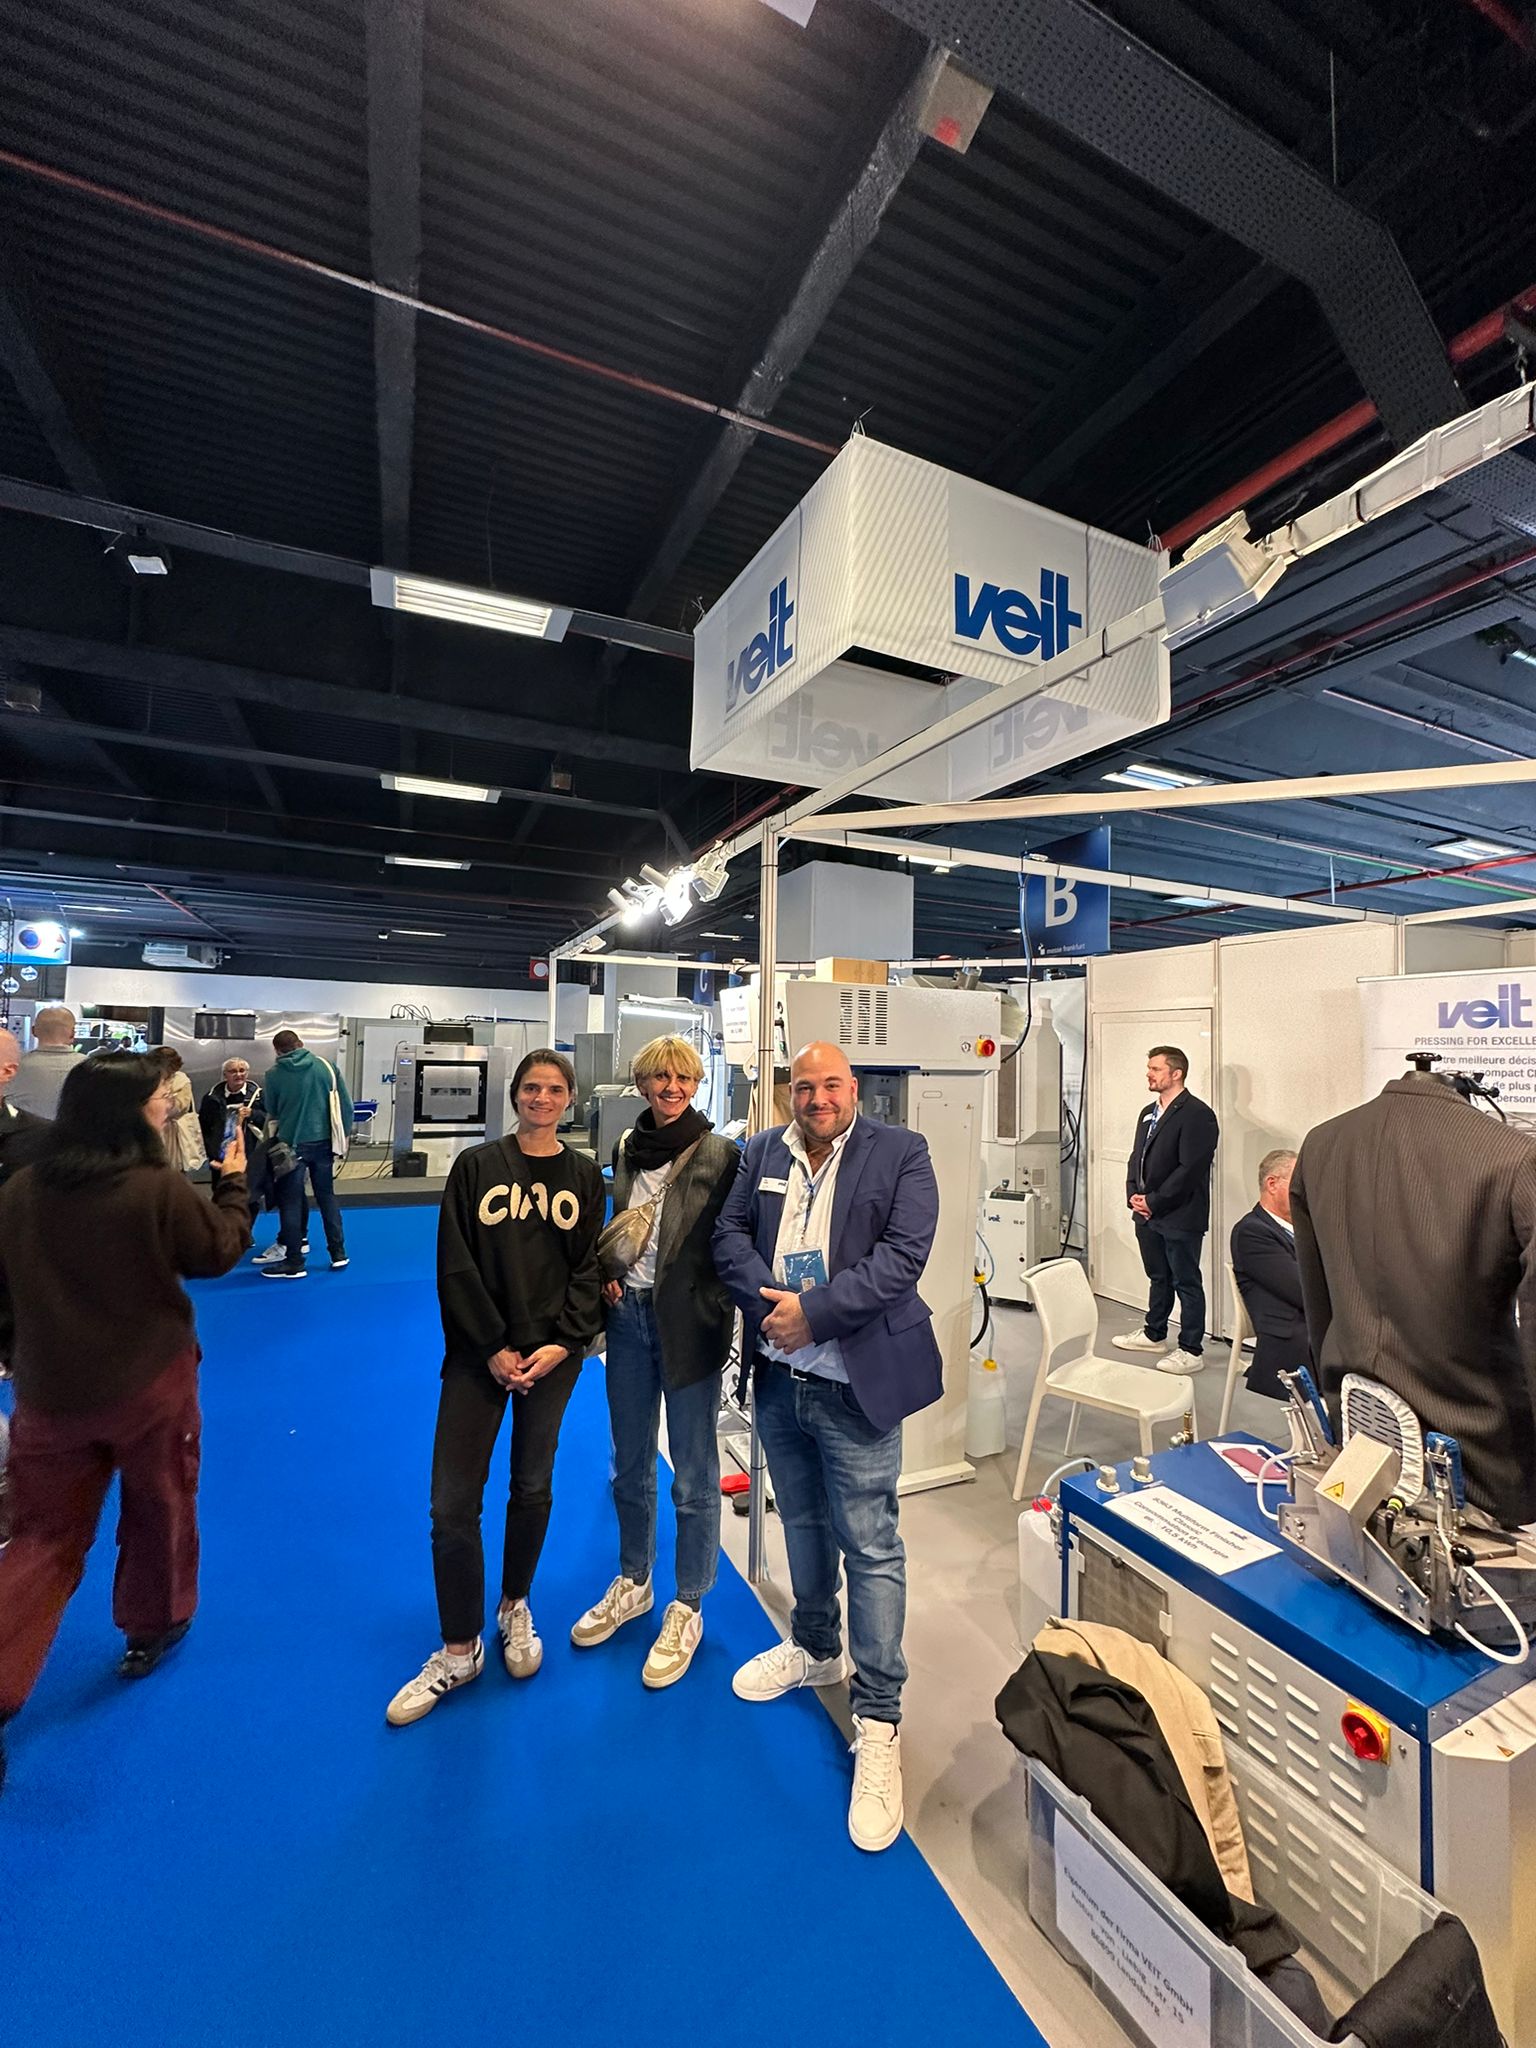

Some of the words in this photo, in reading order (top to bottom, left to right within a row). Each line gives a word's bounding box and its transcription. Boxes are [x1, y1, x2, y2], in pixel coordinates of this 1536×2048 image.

[954, 567, 1083, 662] veit
[725, 575, 795, 714] veit
[1045, 873, 1079, 929] B
[1438, 983, 1533, 1029] veit
[1414, 1036, 1464, 1046] PRESSING
[1466, 1036, 1488, 1046] FOR
[1458, 1055, 1506, 1065] meilleure
[1483, 1069, 1524, 1079] ompact
[1508, 1081, 1531, 1091] plus
[478, 1181, 580, 1231] CIAO
[1063, 1866, 1099, 1911] Eigentum
[1100, 1909, 1114, 1928] der
[1115, 1924, 1140, 1957] Firma
[1141, 1951, 1161, 1980] VEIT
[1163, 1978, 1194, 2017] GmbH
